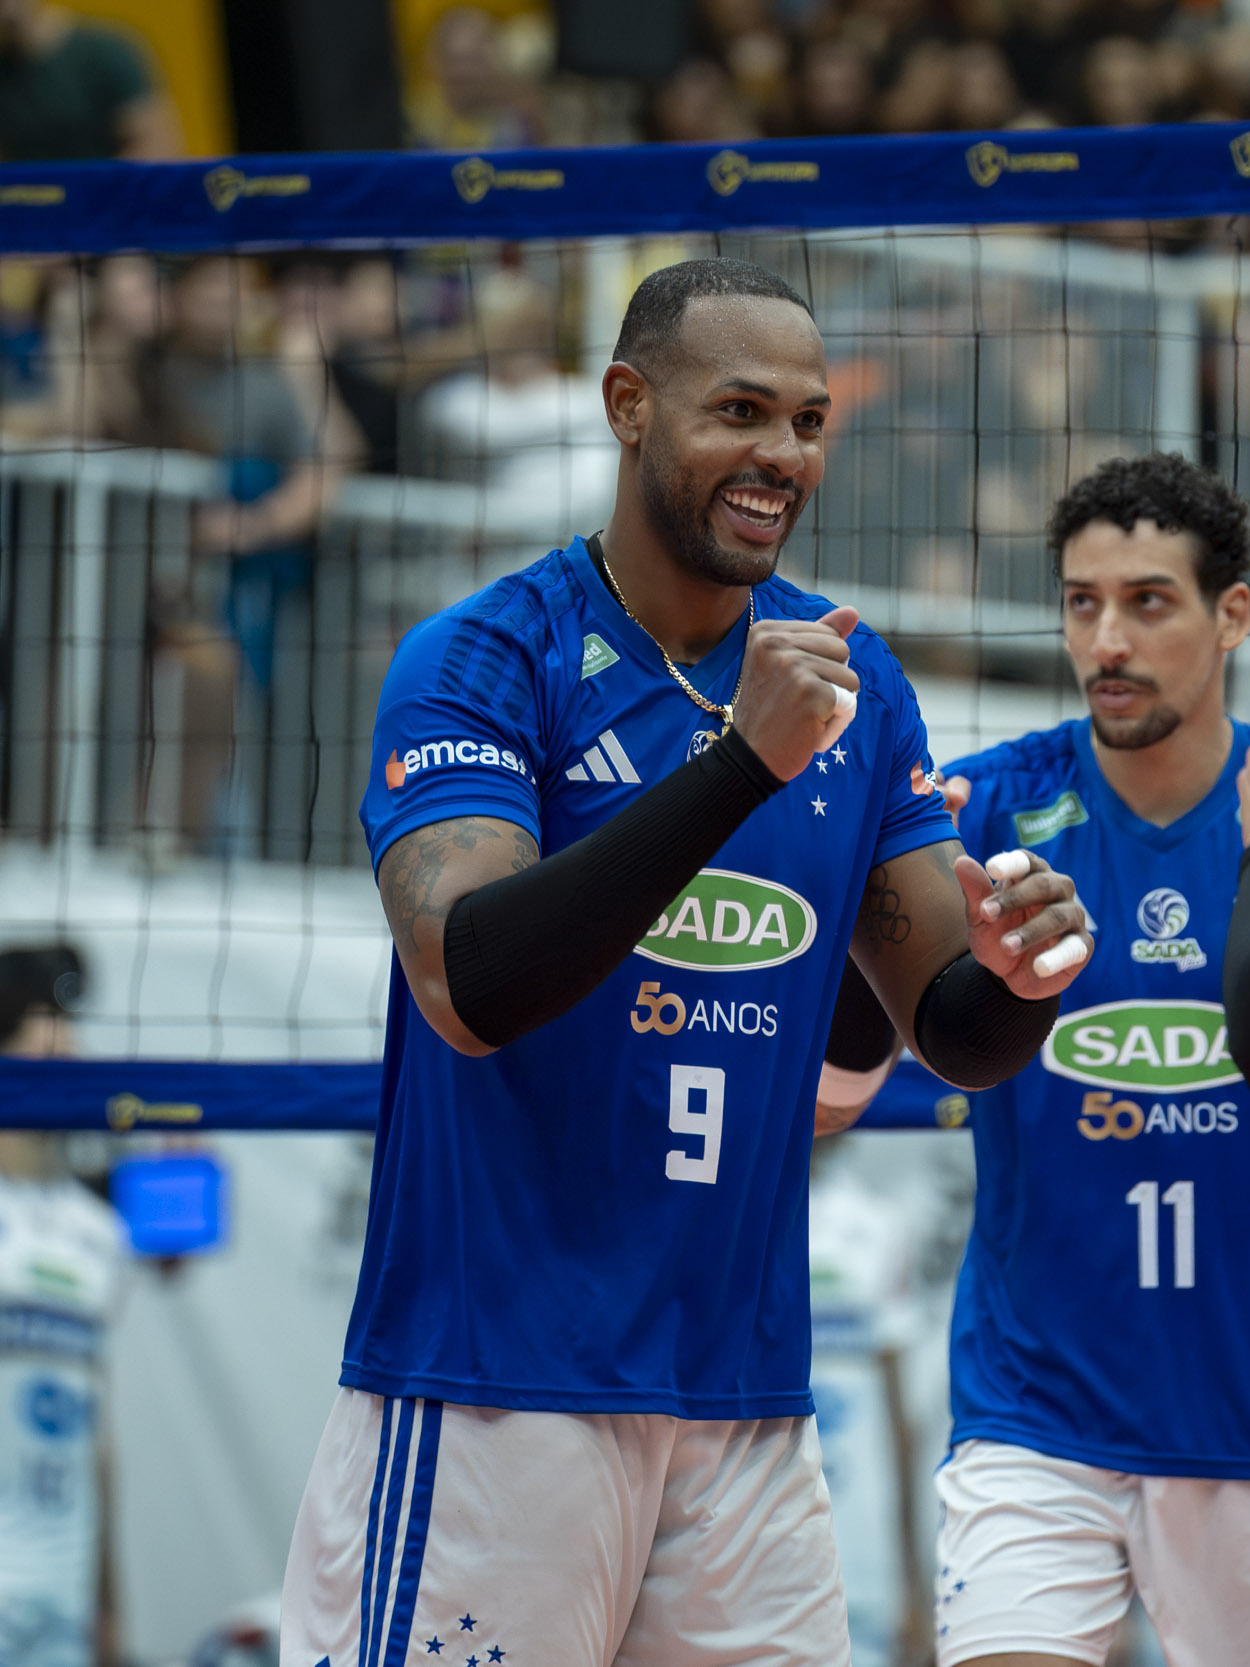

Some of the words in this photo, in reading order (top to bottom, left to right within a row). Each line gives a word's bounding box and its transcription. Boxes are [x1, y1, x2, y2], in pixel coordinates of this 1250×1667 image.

[403, 740, 537, 786] emcas
[1134, 942, 1199, 960] SADA
[687, 999, 778, 1037] ANOS
[665, 1064, 726, 1185] 9
[1144, 1101, 1239, 1134] ANOS
[1125, 1180, 1195, 1289] 11
